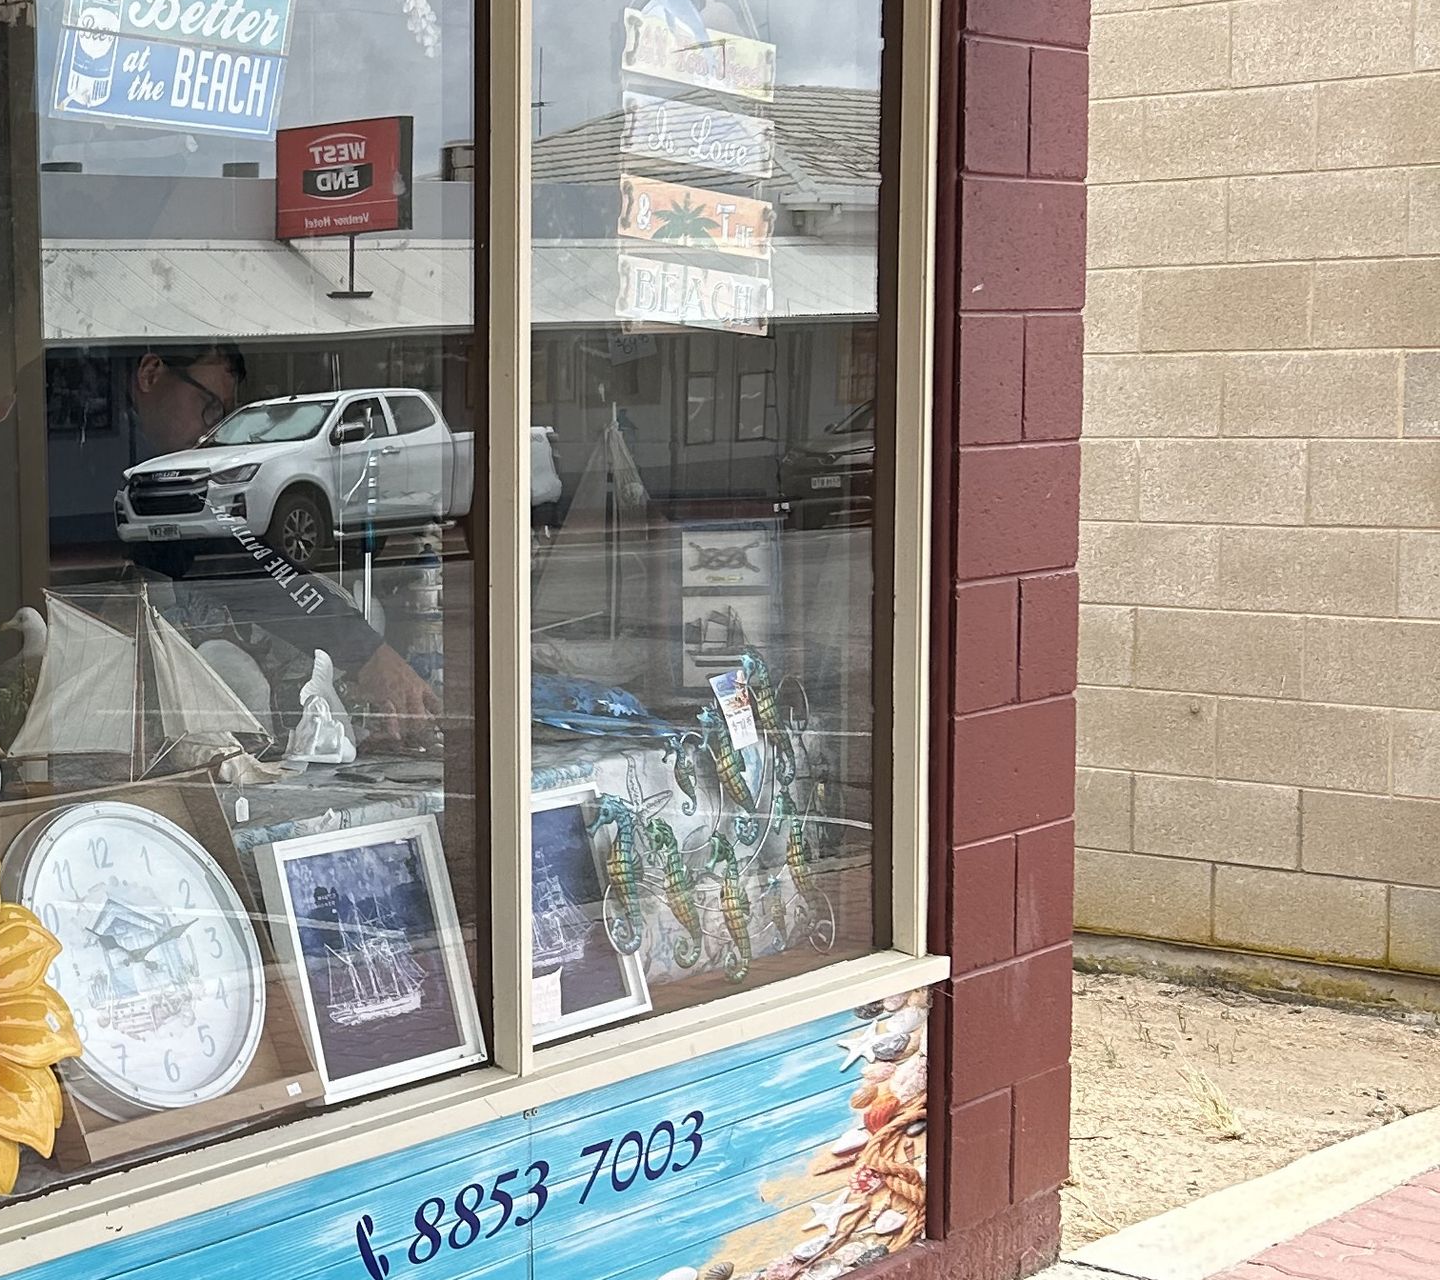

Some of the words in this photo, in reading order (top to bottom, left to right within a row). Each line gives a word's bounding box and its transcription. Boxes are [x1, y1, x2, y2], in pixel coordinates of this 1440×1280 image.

[122, 47, 150, 73] at
[128, 71, 165, 102] the
[170, 47, 272, 117] BEACH
[688, 115, 748, 166] Love
[634, 268, 753, 326] BEACH
[263, 556, 299, 590] THE
[289, 581, 325, 615] LET
[87, 837, 114, 870] 12
[53, 858, 79, 900] 11
[139, 845, 152, 876] 1
[178, 878, 198, 910] 2
[204, 926, 222, 959] 3
[215, 977, 229, 1010] 4
[111, 1043, 129, 1077] 7
[163, 1048, 180, 1084] 6
[197, 1025, 215, 1058] 5
[407, 1157, 551, 1269] 8853
[578, 1110, 706, 1209] 7003
